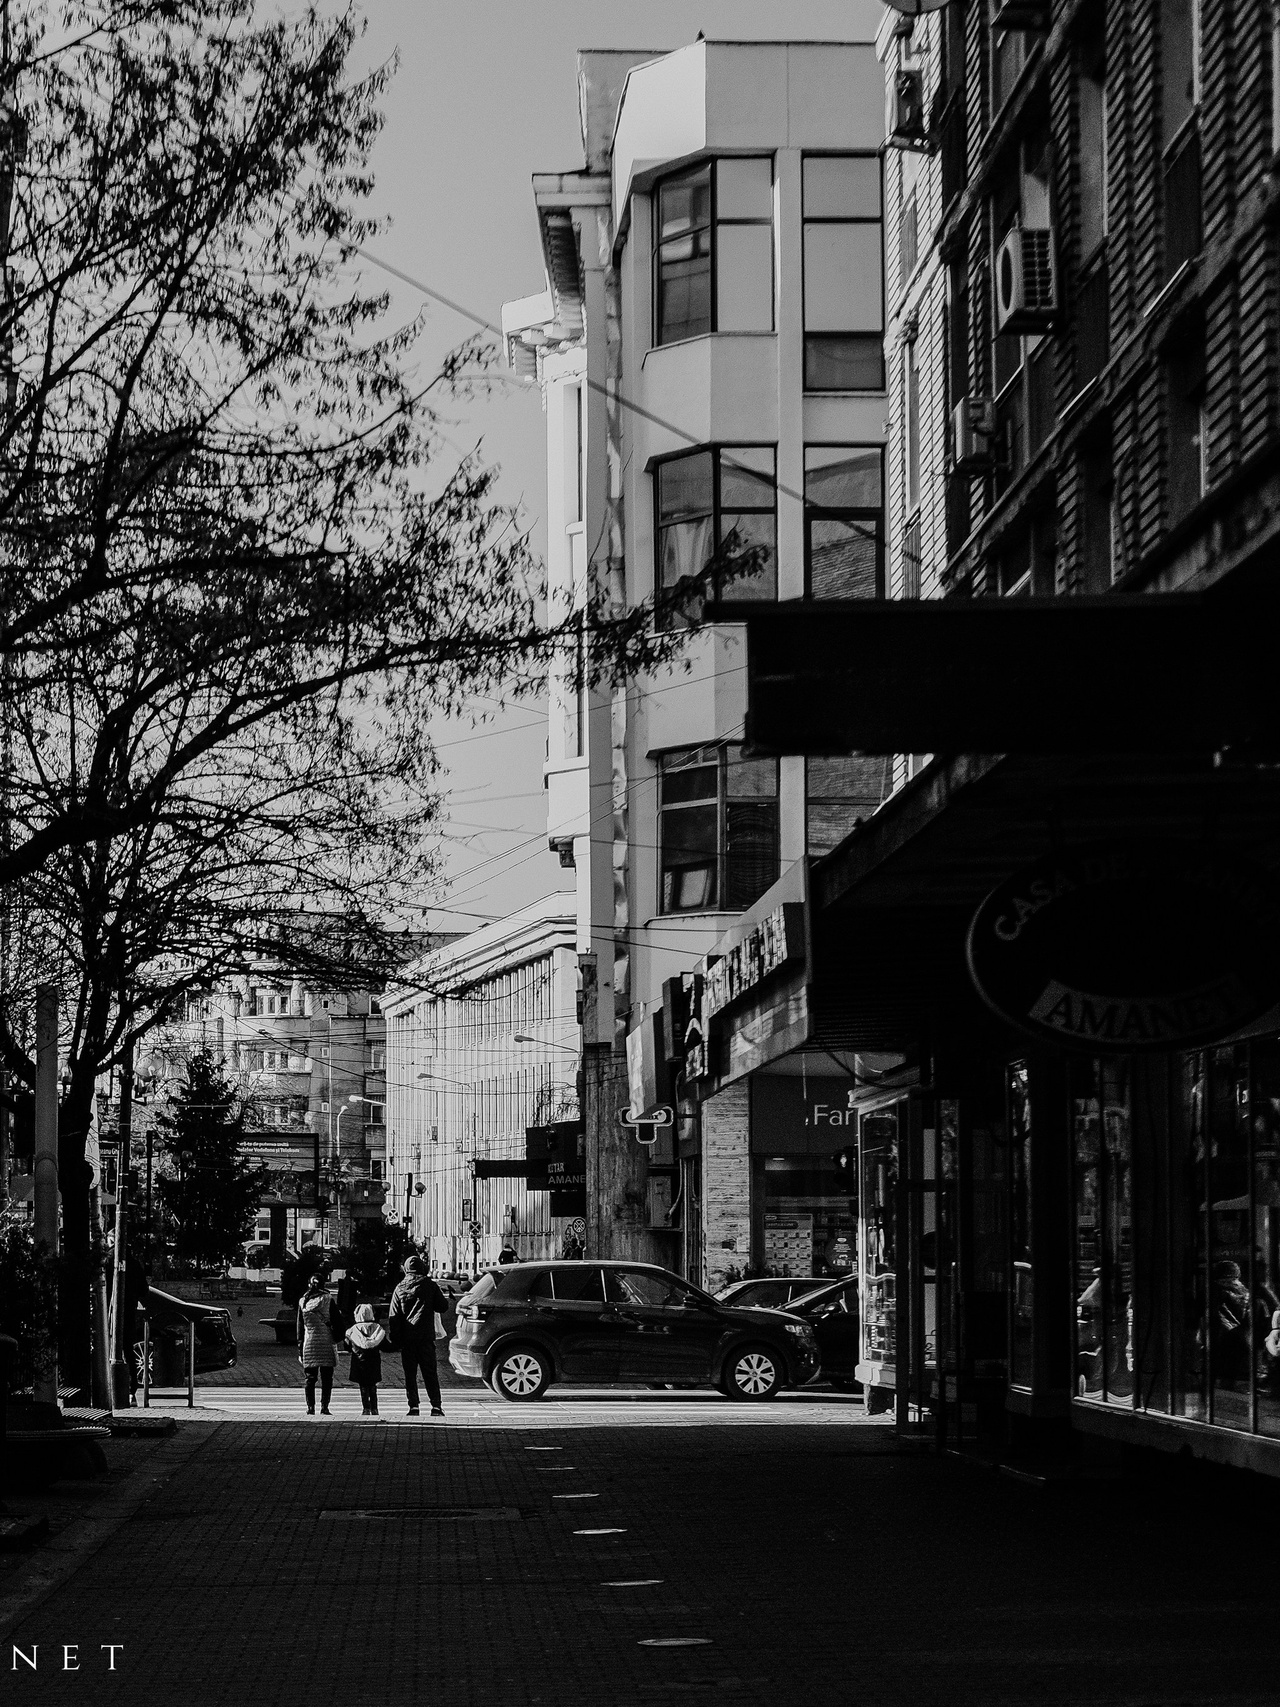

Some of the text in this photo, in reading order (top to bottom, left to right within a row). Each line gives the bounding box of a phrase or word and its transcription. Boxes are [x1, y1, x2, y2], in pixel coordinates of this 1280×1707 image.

[993, 867, 1078, 942] CASA
[1044, 984, 1242, 1039] AMANET
[813, 1104, 854, 1126] Far
[548, 1174, 586, 1184] AMANE
